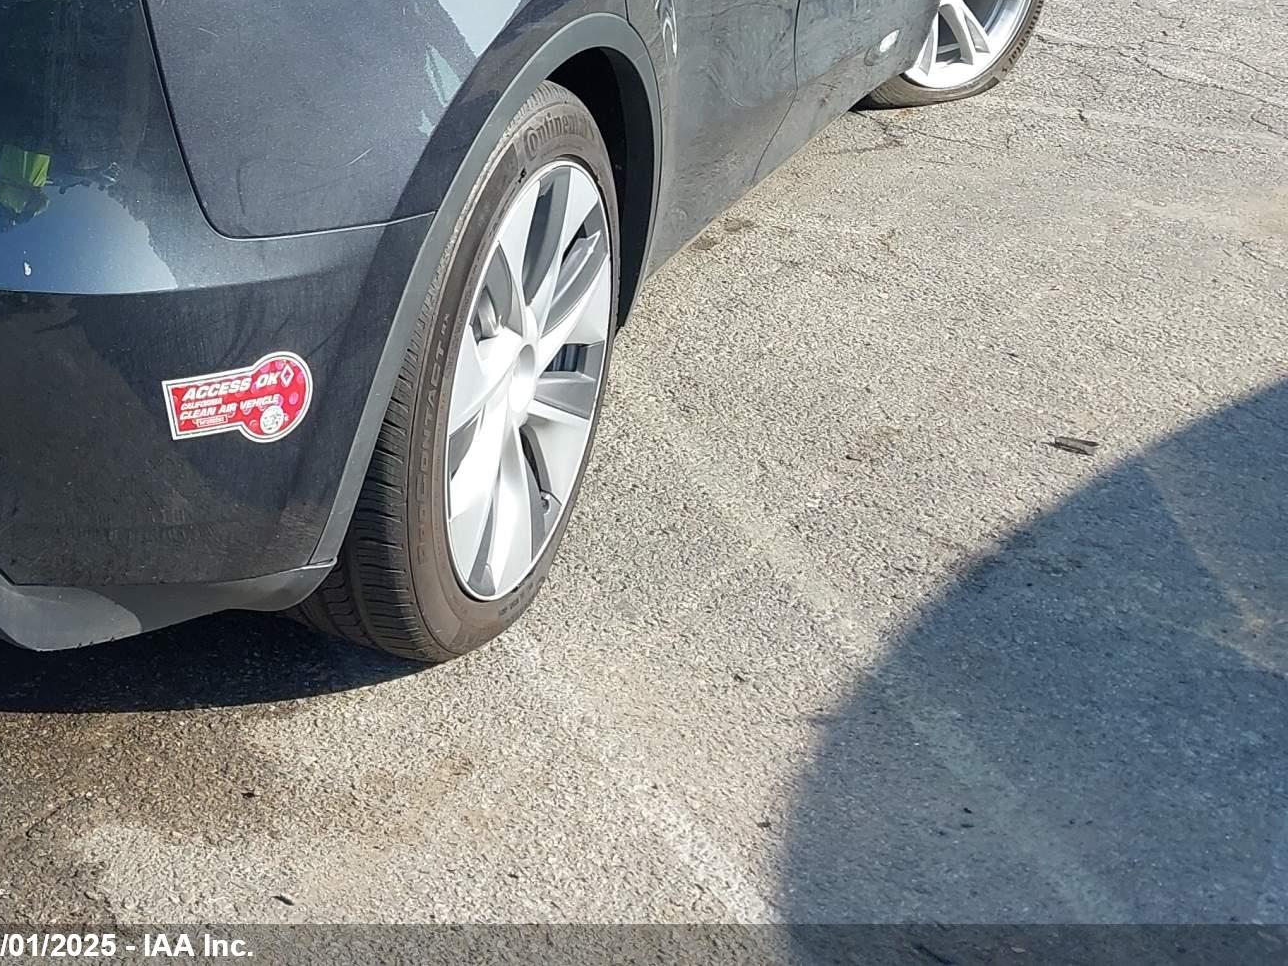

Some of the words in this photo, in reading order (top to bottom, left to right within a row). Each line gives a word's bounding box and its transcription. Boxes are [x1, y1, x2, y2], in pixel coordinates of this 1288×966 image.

[182, 378, 251, 401] ACCESS
[256, 372, 282, 389] OK
[180, 407, 217, 421] CLEAN
[218, 402, 238, 415] AIR
[240, 394, 280, 410] VEHICLE
[181, 397, 223, 410] CALIFORNIA
